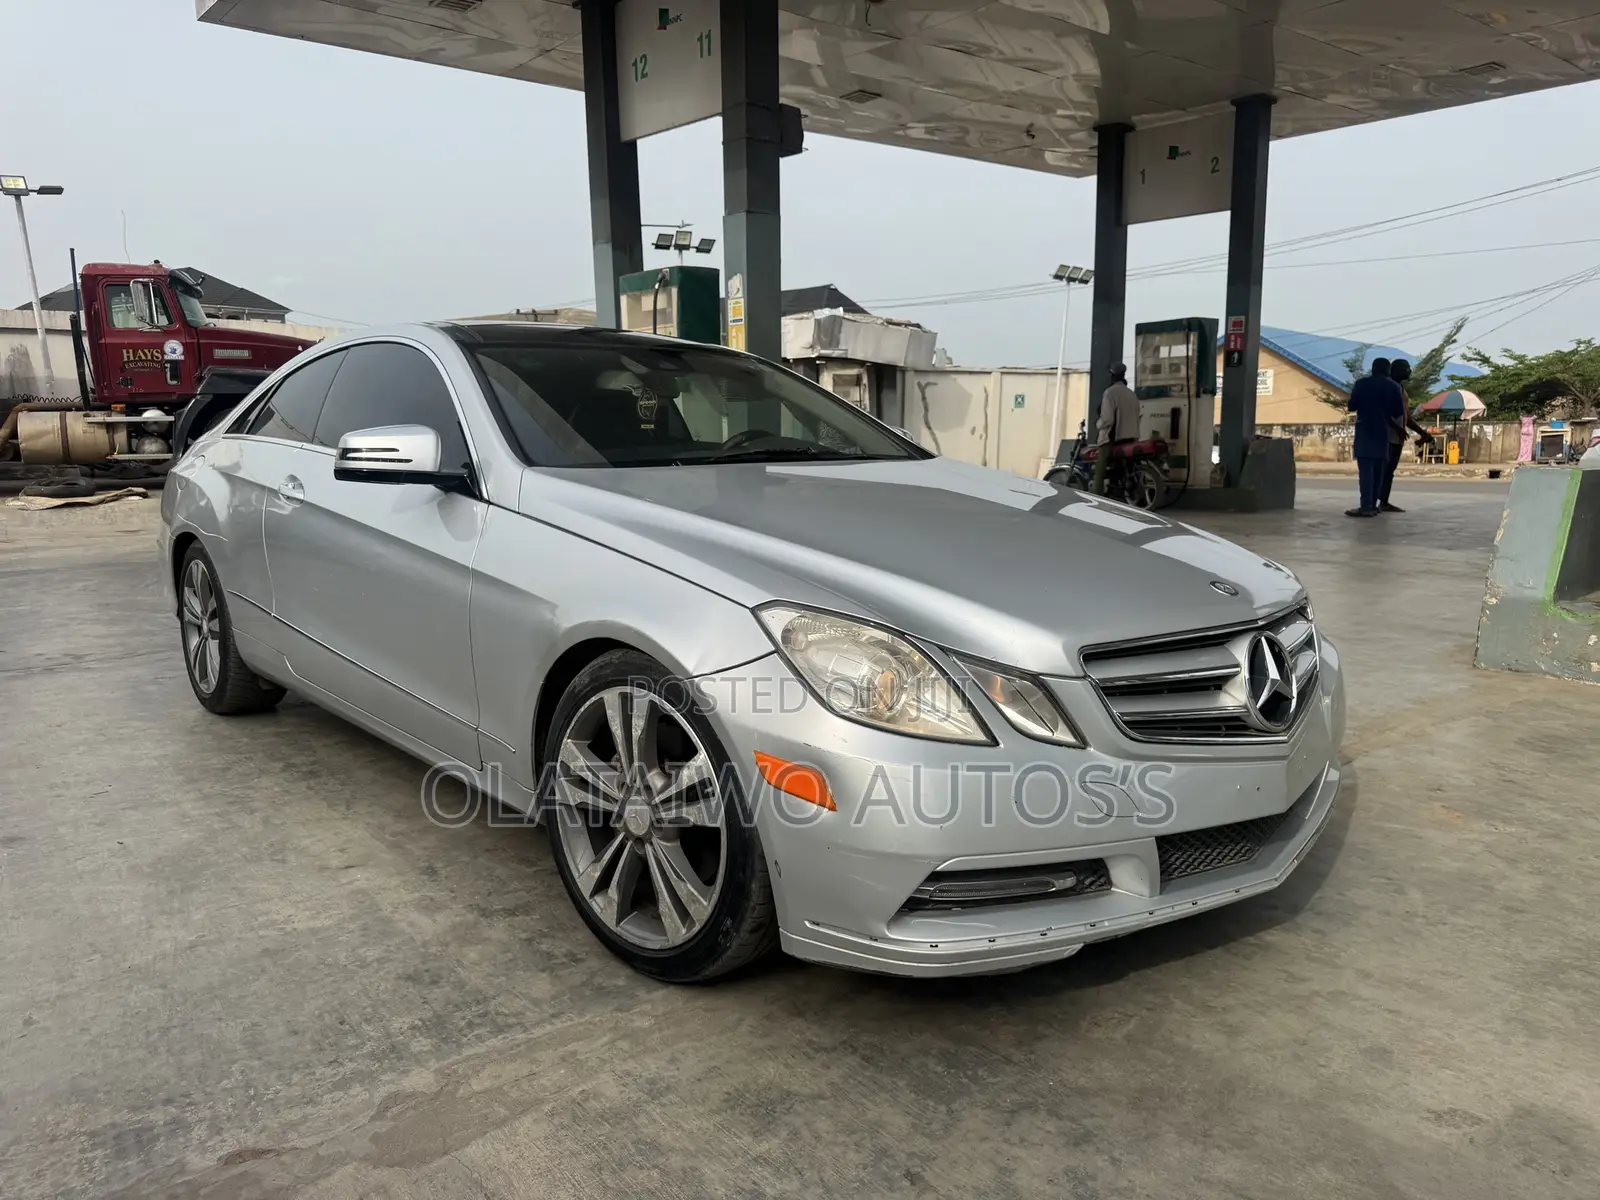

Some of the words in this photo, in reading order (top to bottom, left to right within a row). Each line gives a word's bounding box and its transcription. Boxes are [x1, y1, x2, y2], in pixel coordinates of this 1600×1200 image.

[697, 29, 712, 58] 11
[631, 53, 649, 82] 12
[1210, 156, 1220, 174] 2
[1140, 168, 1146, 185] 1
[122, 348, 163, 361] HAYS
[124, 361, 161, 369] EXCAVATING
